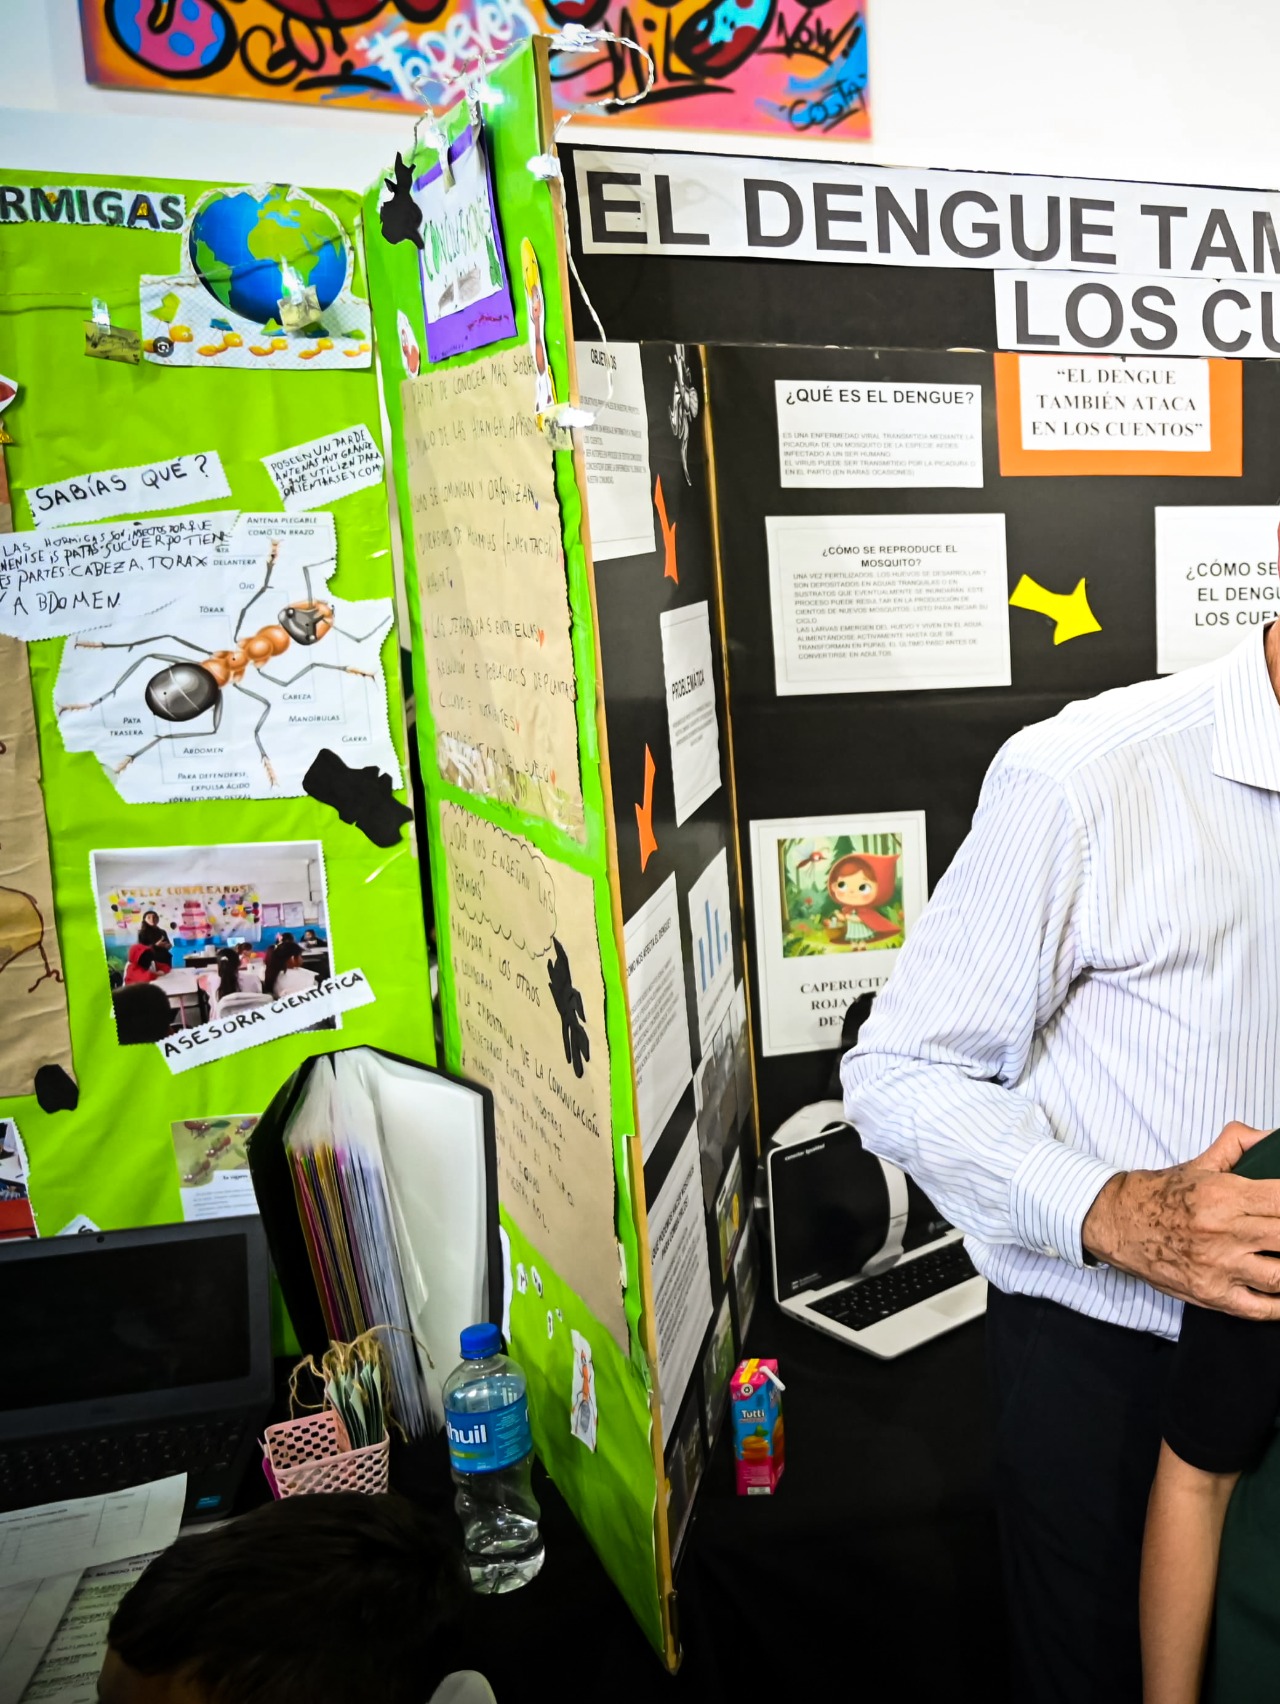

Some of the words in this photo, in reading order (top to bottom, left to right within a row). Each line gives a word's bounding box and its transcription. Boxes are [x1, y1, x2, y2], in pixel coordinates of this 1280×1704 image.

[0, 186, 184, 230] RMIGAS
[585, 171, 709, 247] EL
[743, 178, 1117, 266] DENGUE
[1014, 280, 1178, 350] LOS
[1097, 368, 1177, 385] DENGUE
[786, 386, 833, 405] ¿QUÉ
[838, 388, 861, 403] ES
[866, 389, 888, 403] EL
[893, 390, 974, 405] DENGUE?
[1036, 392, 1126, 411] TAMBIÉN
[1132, 396, 1197, 411] ATACA
[1031, 421, 1057, 436] EN
[1063, 421, 1100, 436] LOS
[35, 475, 128, 512] SABÍAS
[141, 456, 189, 488] QUÉ
[3, 543, 31, 558] LAS
[822, 543, 860, 558] ¿CÓMO
[863, 546, 876, 555] SE
[879, 545, 942, 555] REPRODUCE
[945, 545, 958, 553] EL
[861, 558, 922, 569] MOSQUITO?
[1186, 558, 1251, 581] ¿CÓMO
[1198, 587, 1219, 602] EL
[1195, 611, 1230, 626] LOS
[811, 998, 848, 1011] ROJA
[163, 1008, 267, 1059] ASESORA
[741, 1409, 765, 1419] Tutti
